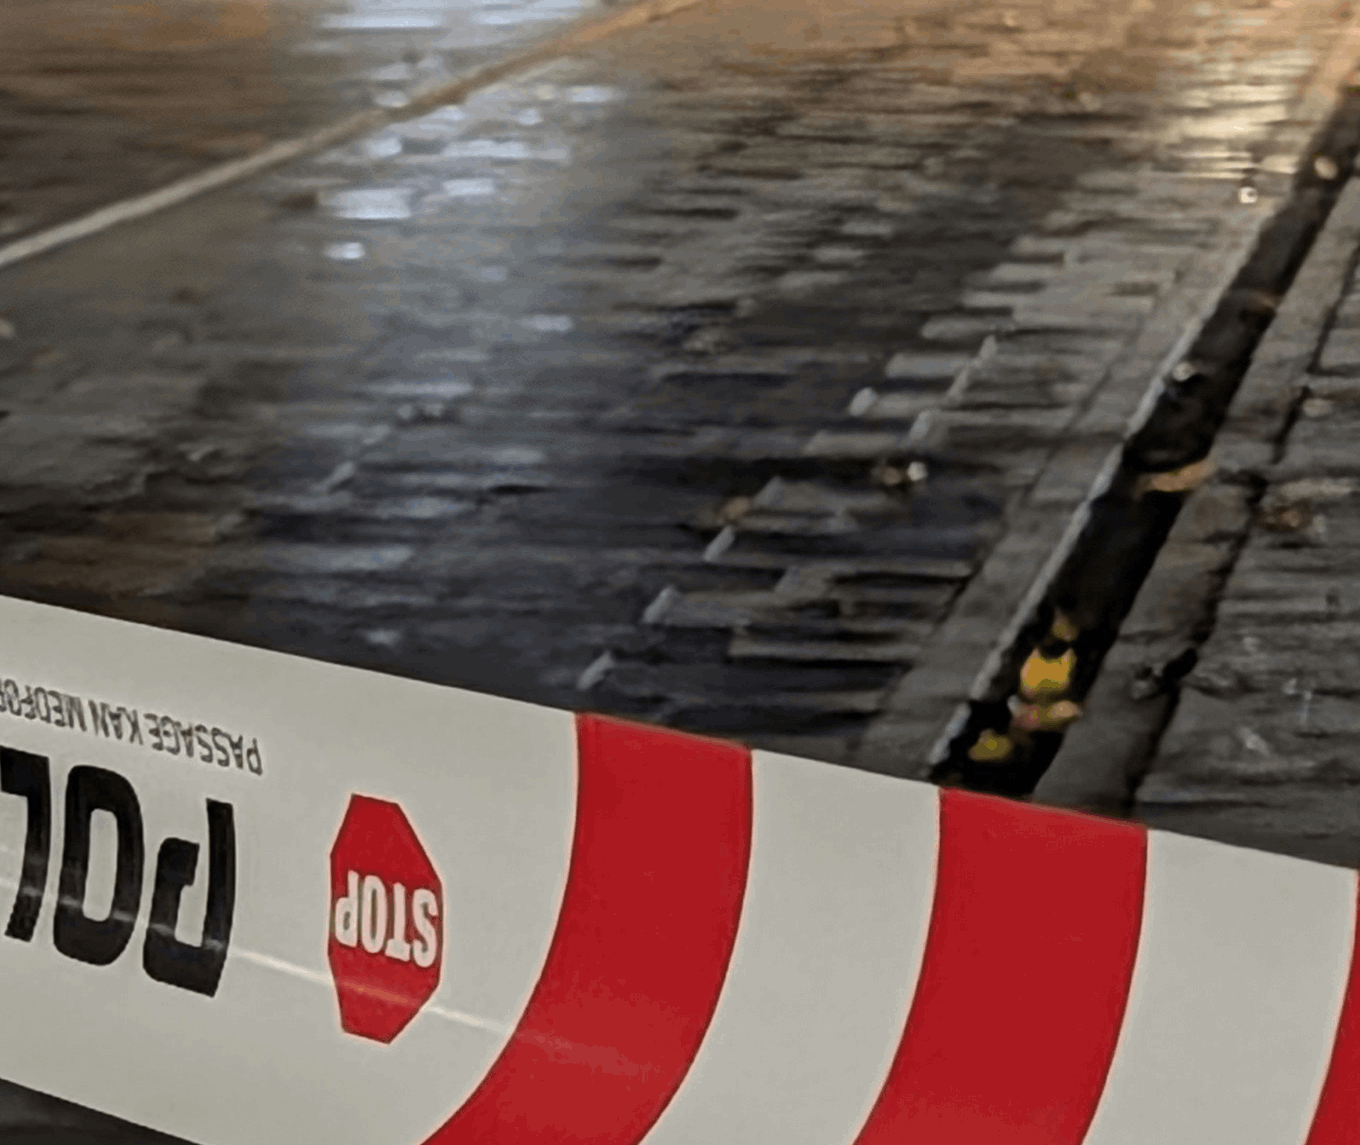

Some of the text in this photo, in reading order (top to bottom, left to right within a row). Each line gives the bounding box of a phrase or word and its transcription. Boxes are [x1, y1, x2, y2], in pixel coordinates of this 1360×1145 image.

[88, 699, 144, 747] KAN
[144, 713, 264, 776] PASSAGE
[335, 869, 439, 968] STOP
